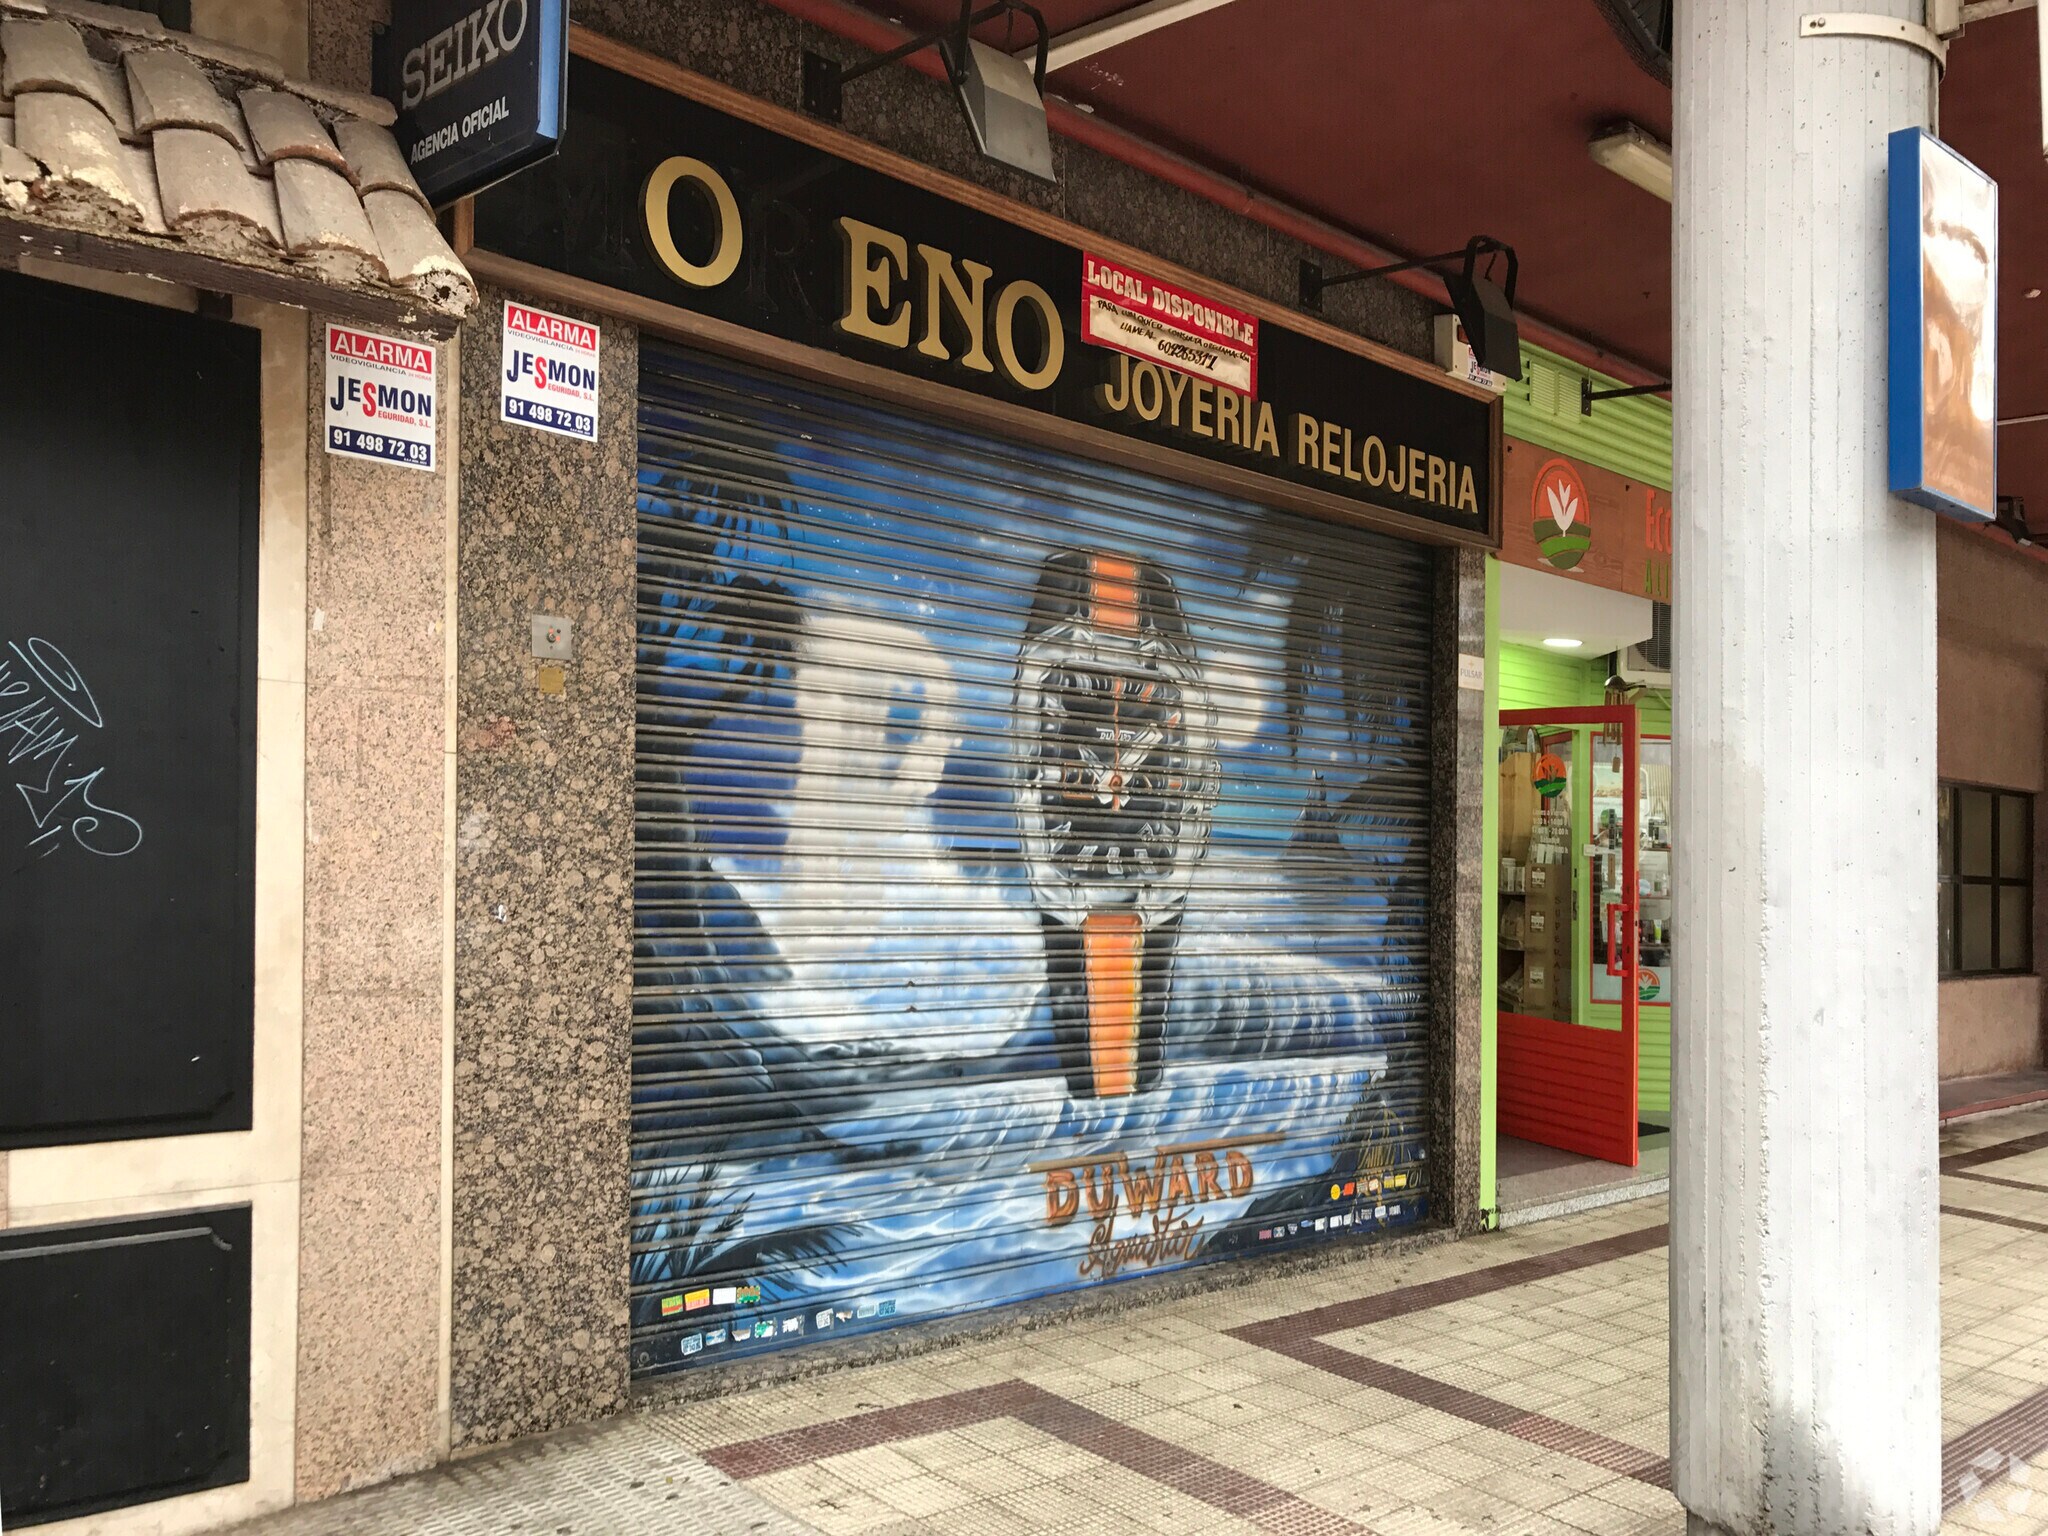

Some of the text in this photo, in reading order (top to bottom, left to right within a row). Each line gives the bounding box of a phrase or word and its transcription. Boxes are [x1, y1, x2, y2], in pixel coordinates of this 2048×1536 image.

[402, 0, 528, 110] SEIKO
[411, 96, 510, 166] AGENCIA OFICIAL
[1087, 259, 1254, 347] LOCAL DISPONIBLE
[1097, 300, 1118, 315] PARA
[507, 329, 574, 352] VIDEOVIGILANCIA
[511, 309, 593, 349] ALARMA
[330, 354, 407, 376] VIDEOVIGILANCIA
[334, 332, 428, 372] ALARMA
[506, 349, 596, 391] JESMON
[330, 375, 432, 418] JESMON
[509, 399, 525, 416] 91
[529, 404, 553, 423] 498
[556, 410, 572, 427] 72
[575, 415, 591, 432] 03
[333, 428, 351, 446] 91
[356, 433, 384, 453] 498
[388, 439, 405, 457] 72
[409, 444, 427, 461] 03
[1105, 354, 1479, 515] JOYERIA RELOJERIA
[1042, 1147, 1255, 1225] DUWARD
